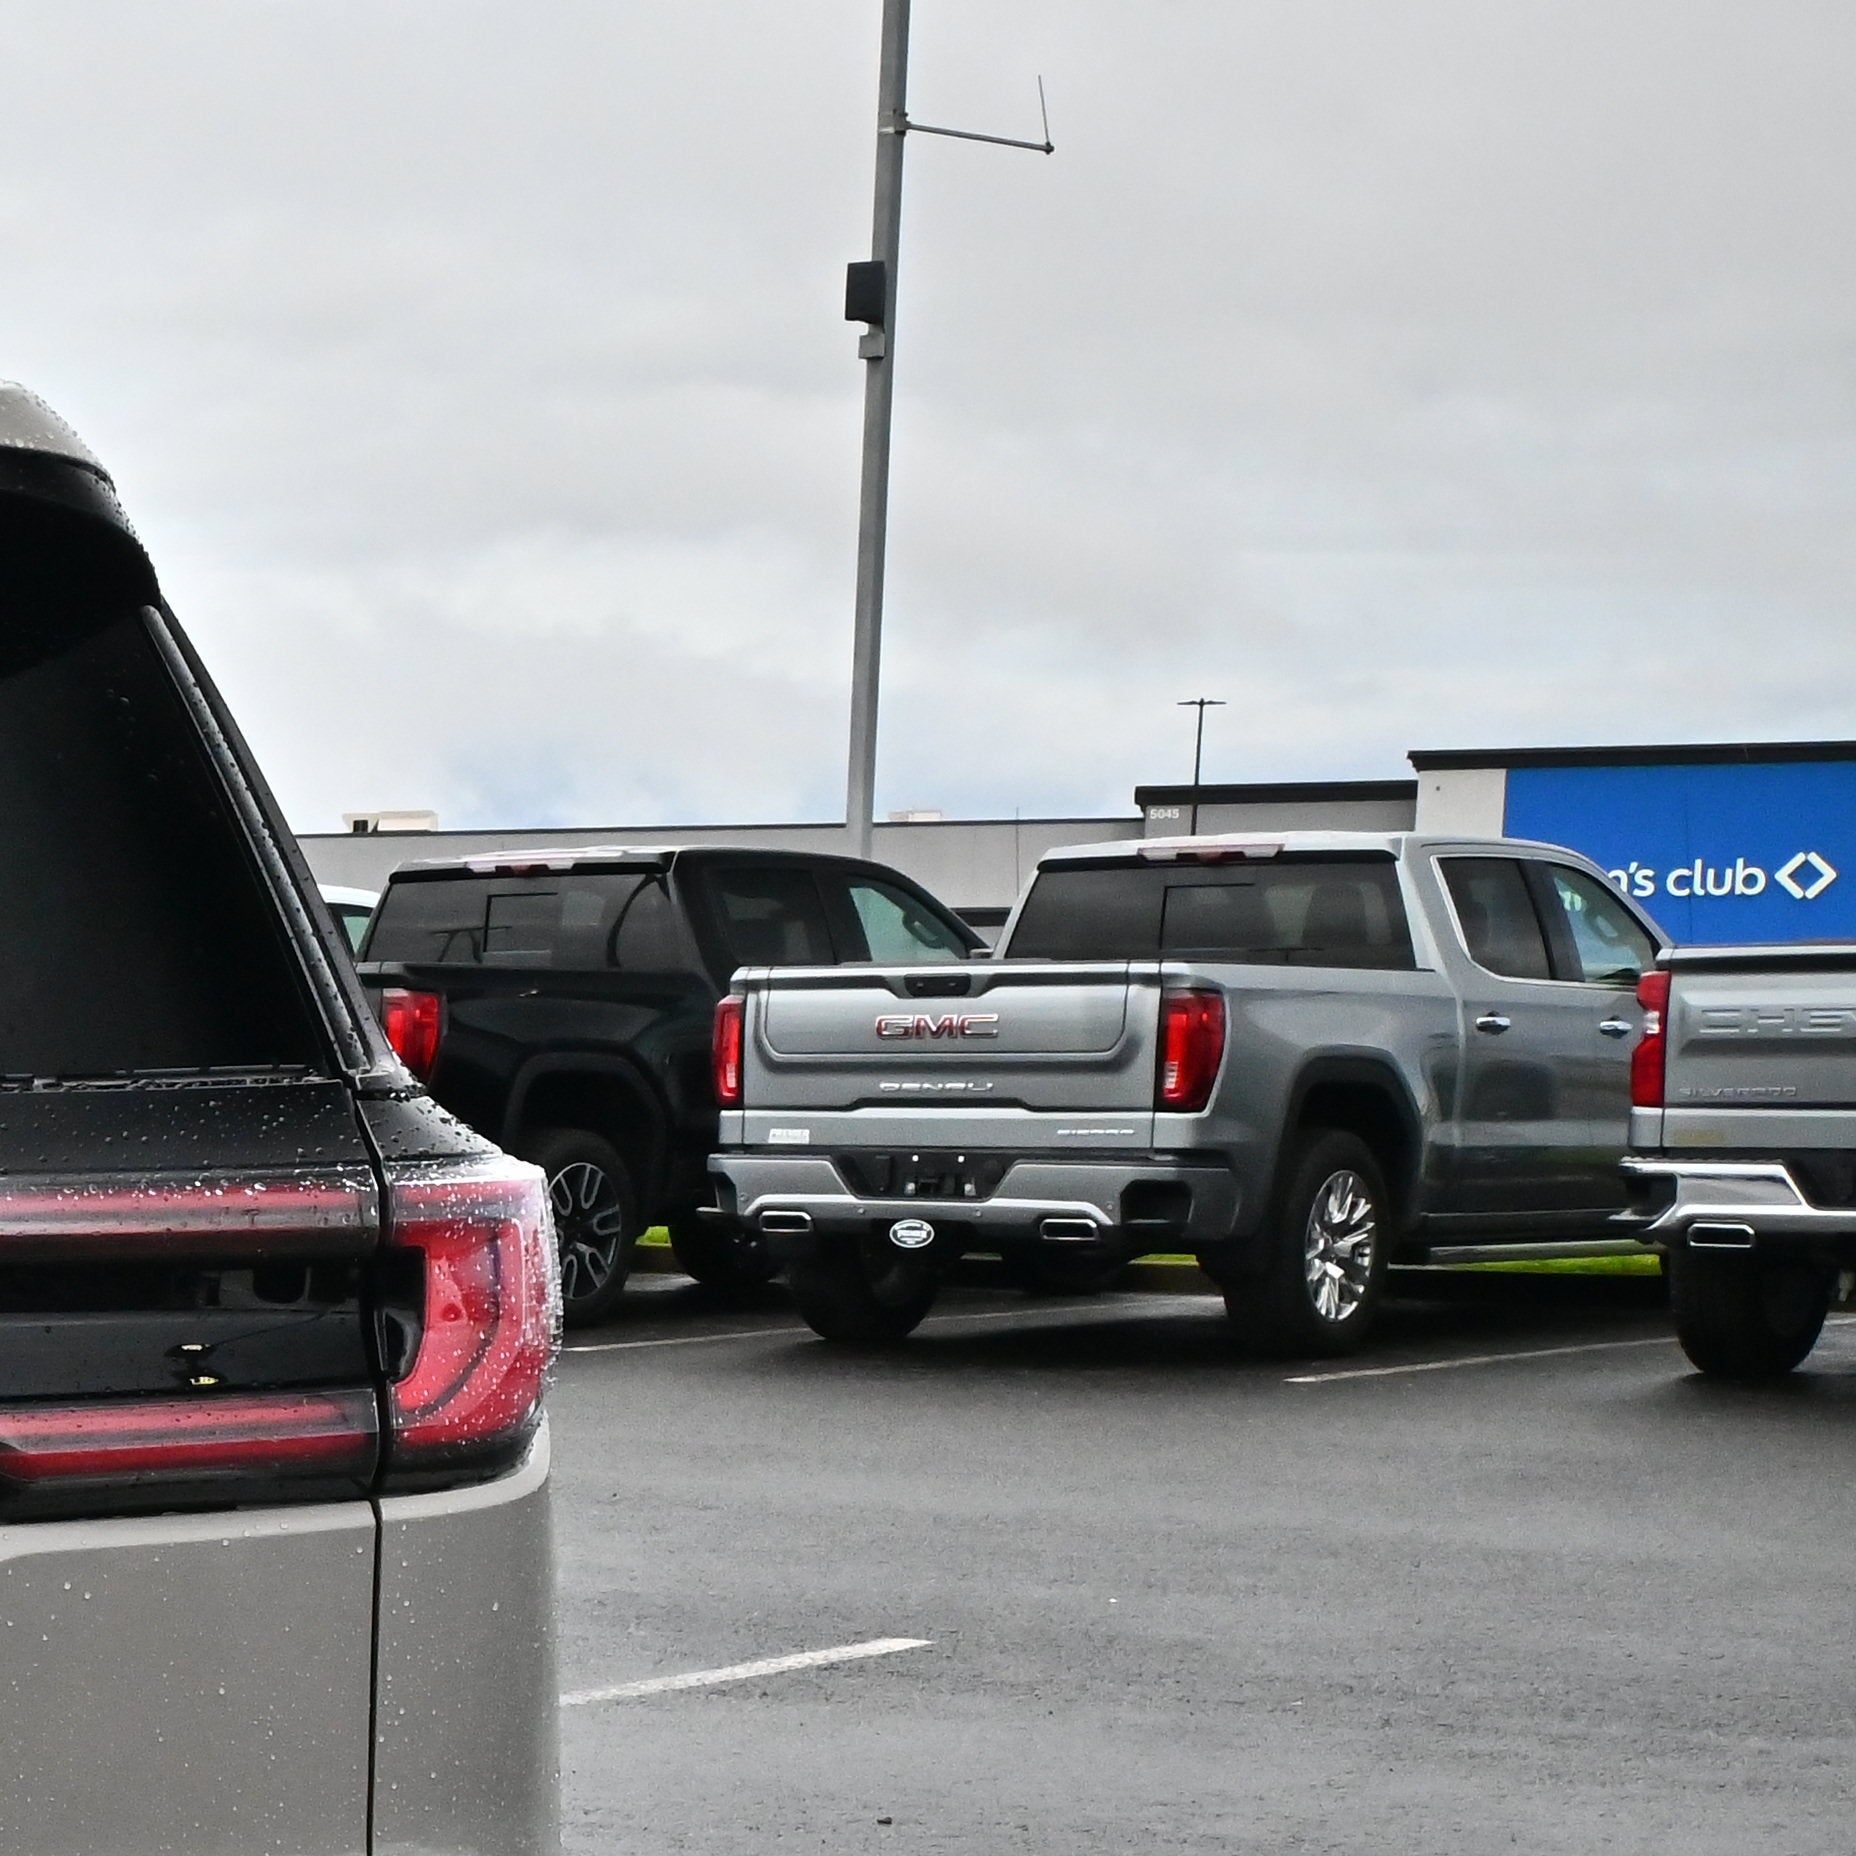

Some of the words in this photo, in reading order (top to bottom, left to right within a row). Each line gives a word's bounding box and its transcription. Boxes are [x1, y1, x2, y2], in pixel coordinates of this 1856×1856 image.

[1666, 857, 1767, 897] club
[875, 1013, 999, 1039] GMC
[1698, 1007, 1856, 1033] CHE
[879, 1082, 994, 1093] DENALI
[1678, 1086, 1797, 1097] SILVERADO
